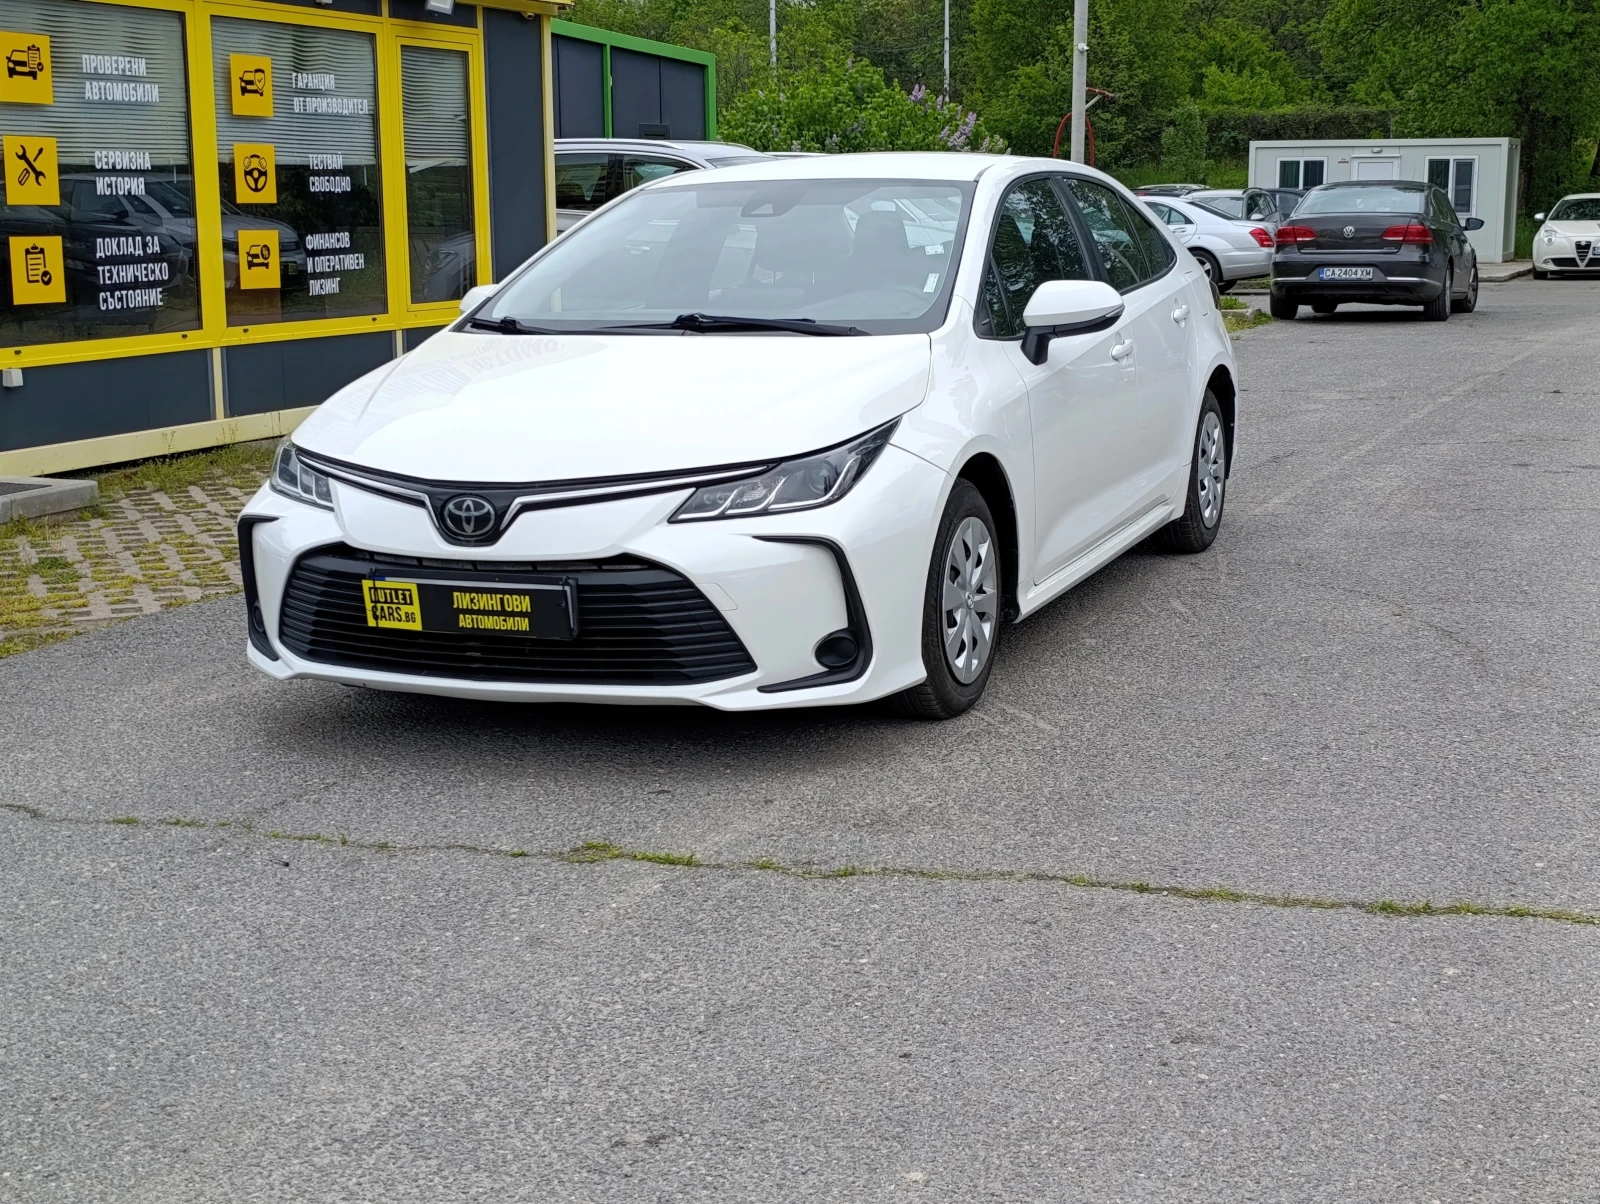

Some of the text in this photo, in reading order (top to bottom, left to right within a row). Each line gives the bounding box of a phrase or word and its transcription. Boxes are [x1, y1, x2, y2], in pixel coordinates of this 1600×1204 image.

[82, 54, 147, 77] ПРОВЕРЕНИ
[84, 81, 160, 103] АВТОМОБИЛИ
[292, 72, 335, 91] ГАРАНЦИЯ
[293, 98, 369, 116] ОТ ПРОИЗВОДИТЕЛ
[94, 150, 152, 171] СЕРВИЗНА
[308, 152, 344, 171] ТЕСТВАЙ
[95, 176, 146, 197] ИСТОРИЯ
[309, 175, 351, 193] СВОБОДНО
[95, 236, 161, 259] ДОКЛАД ЗА
[305, 232, 351, 250] ФИНАНСОВ
[97, 262, 169, 285] ТЕХНИЧЕСКО
[306, 253, 365, 274] И ОПЕРАТИВЕН
[308, 277, 341, 297] ЛИЗИНГ
[99, 288, 164, 311] СЪСТОЯНИЕ
[452, 591, 532, 613] ЛИЗИНГОВИ
[458, 613, 530, 632] АВТОМОБИЛИ
